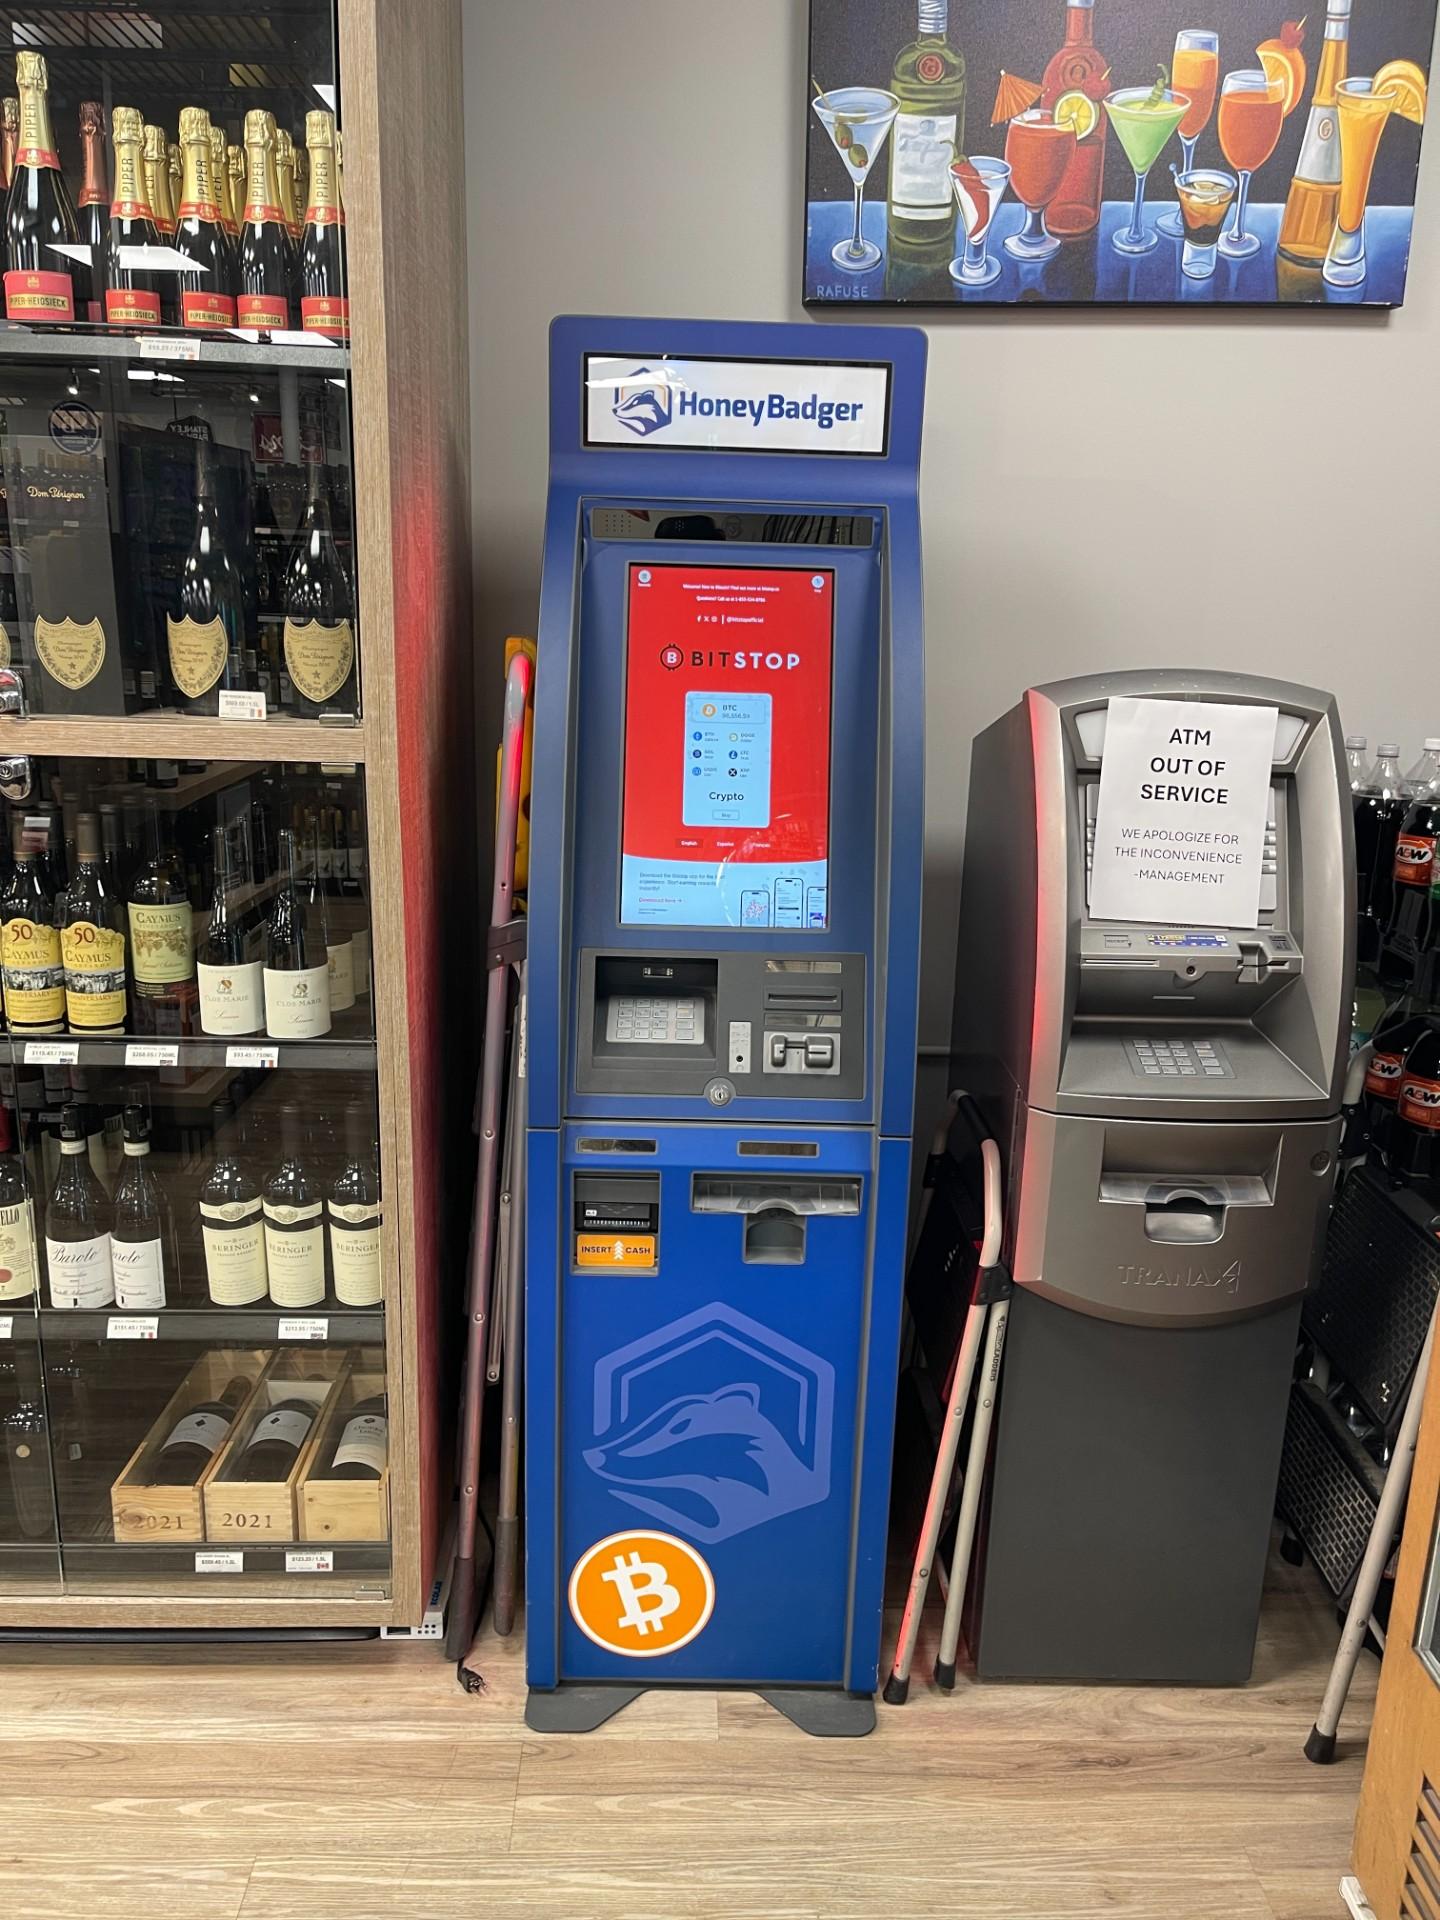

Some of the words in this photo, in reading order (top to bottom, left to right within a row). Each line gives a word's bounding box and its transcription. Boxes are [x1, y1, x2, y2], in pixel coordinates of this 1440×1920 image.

[25, 103, 37, 138] PIPER
[121, 158, 134, 194] PIPER
[196, 159, 209, 197] PIPER
[252, 161, 265, 198] PIPER
[316, 161, 329, 198] PIPER
[816, 284, 869, 298] RAFUSE
[10, 296, 66, 308] PIPER-HEIDSIECK
[679, 390, 863, 429] HoneyBadger
[27, 485, 49, 497] Dom
[691, 650, 801, 670] BITSTOP
[1169, 728, 1211, 746] ATM
[1150, 757, 1193, 775] OUT
[1197, 760, 1226, 777] OF
[709, 791, 744, 802] Crypto
[1140, 783, 1229, 804] SERVICE
[1121, 827, 1142, 840] WE
[1143, 829, 1211, 844] APOLOGIZE
[1214, 832, 1239, 845] FOR
[1114, 846, 1138, 858] THE
[1140, 848, 1243, 864] INCONVENIENCE
[1397, 846, 1429, 861] A&W
[1133, 870, 1225, 884] -MANAGEMENT
[11, 924, 33, 943] 50
[74, 927, 96, 946] 50
[1404, 1086, 1440, 1105] A&W
[0, 1208, 20, 1227] ELLO
[211, 1238, 259, 1251] BERINGER
[581, 1246, 612, 1254] INSERT
[51, 1246, 99, 1264] Barolo
[133, 1513, 185, 1530] 2021
[221, 1512, 273, 1529] 2021
